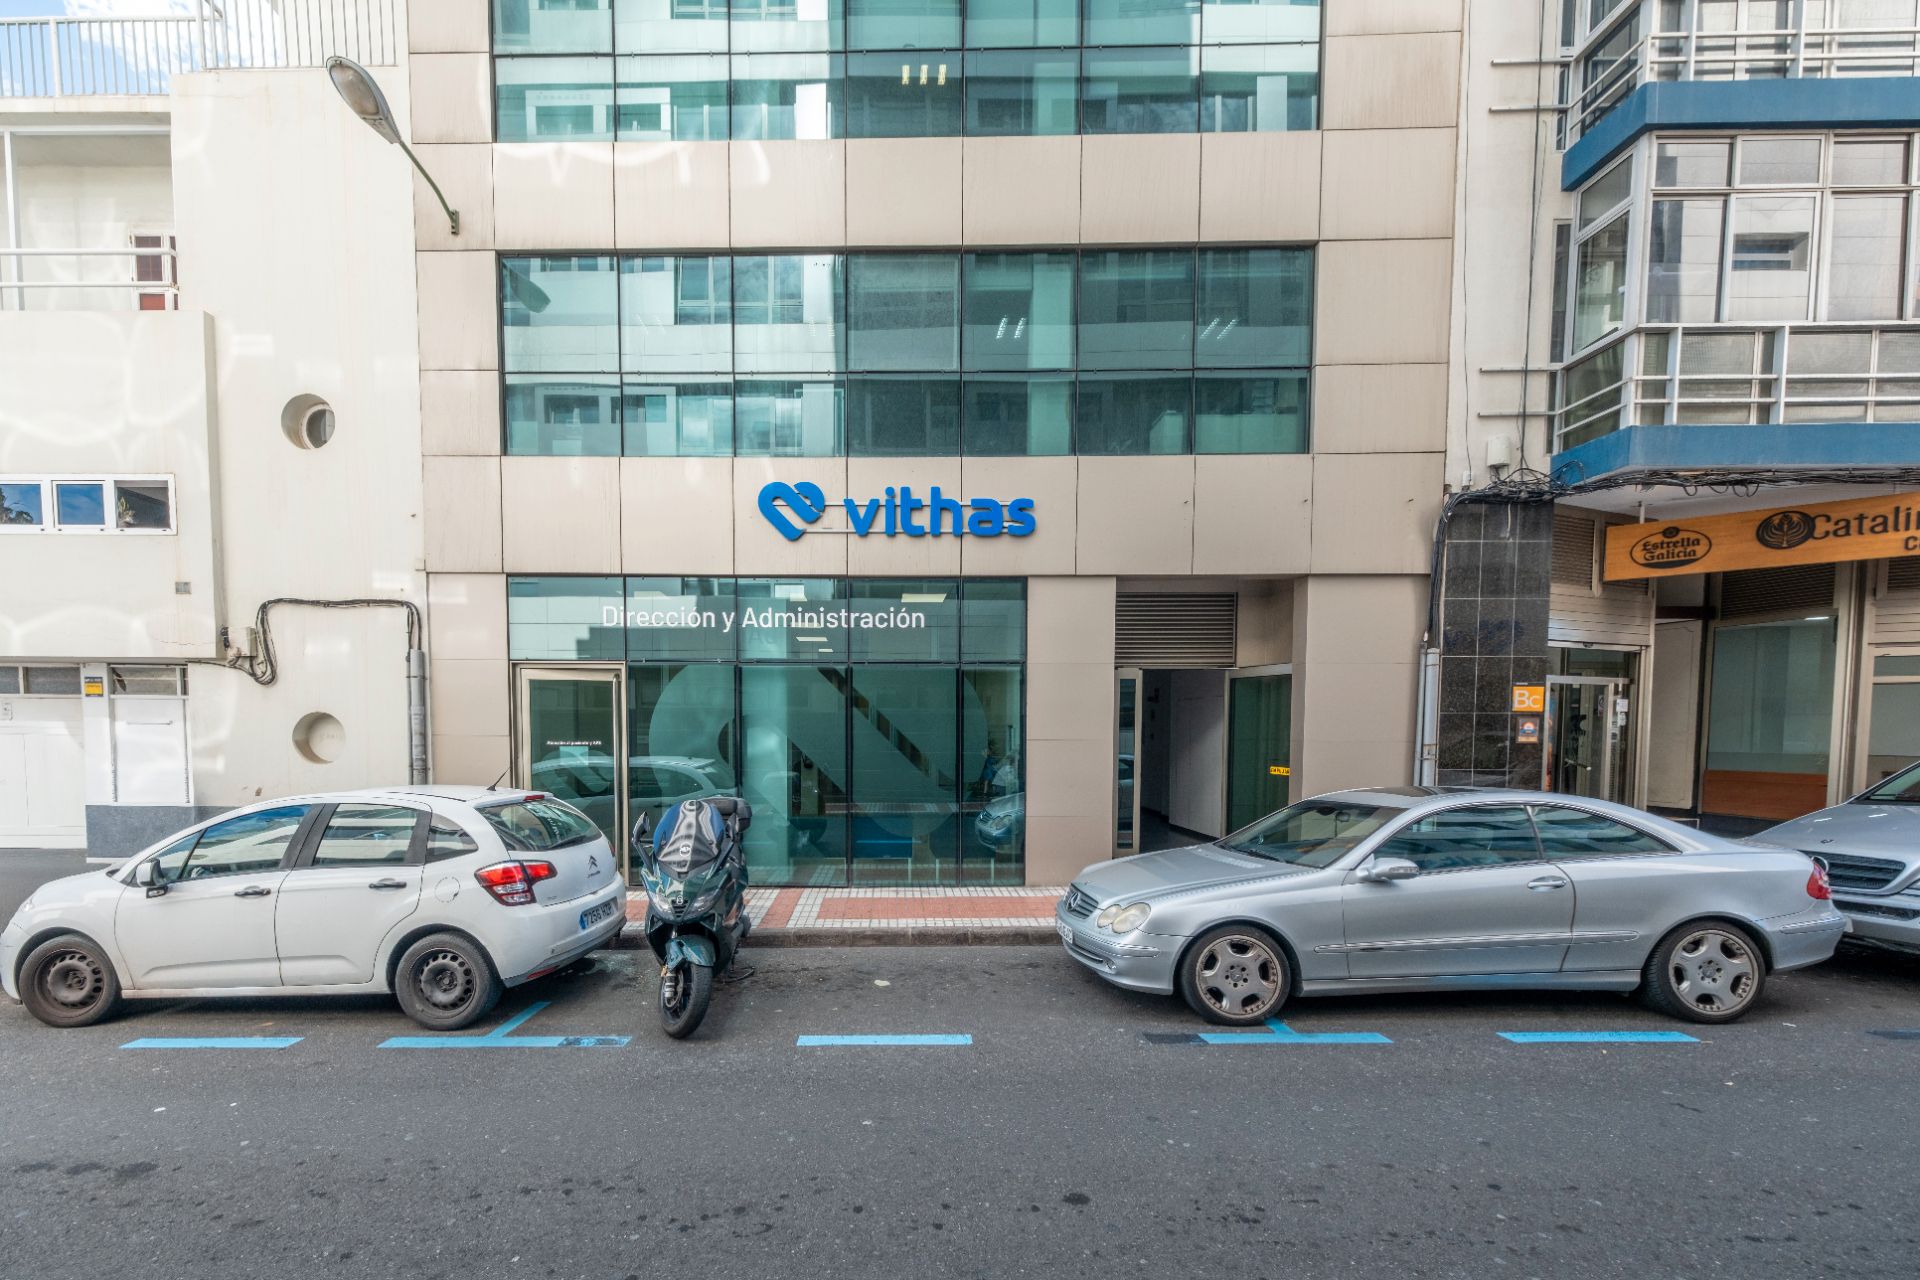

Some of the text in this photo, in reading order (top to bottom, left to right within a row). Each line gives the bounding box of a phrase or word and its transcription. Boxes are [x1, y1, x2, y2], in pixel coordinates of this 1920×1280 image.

[843, 486, 1036, 537] vithas
[1641, 537, 1701, 552] Estrella
[1904, 535, 1920, 551] C
[1643, 547, 1697, 562] Galicia
[602, 605, 925, 632] Dirección y Administración
[1514, 690, 1540, 708] Bc
